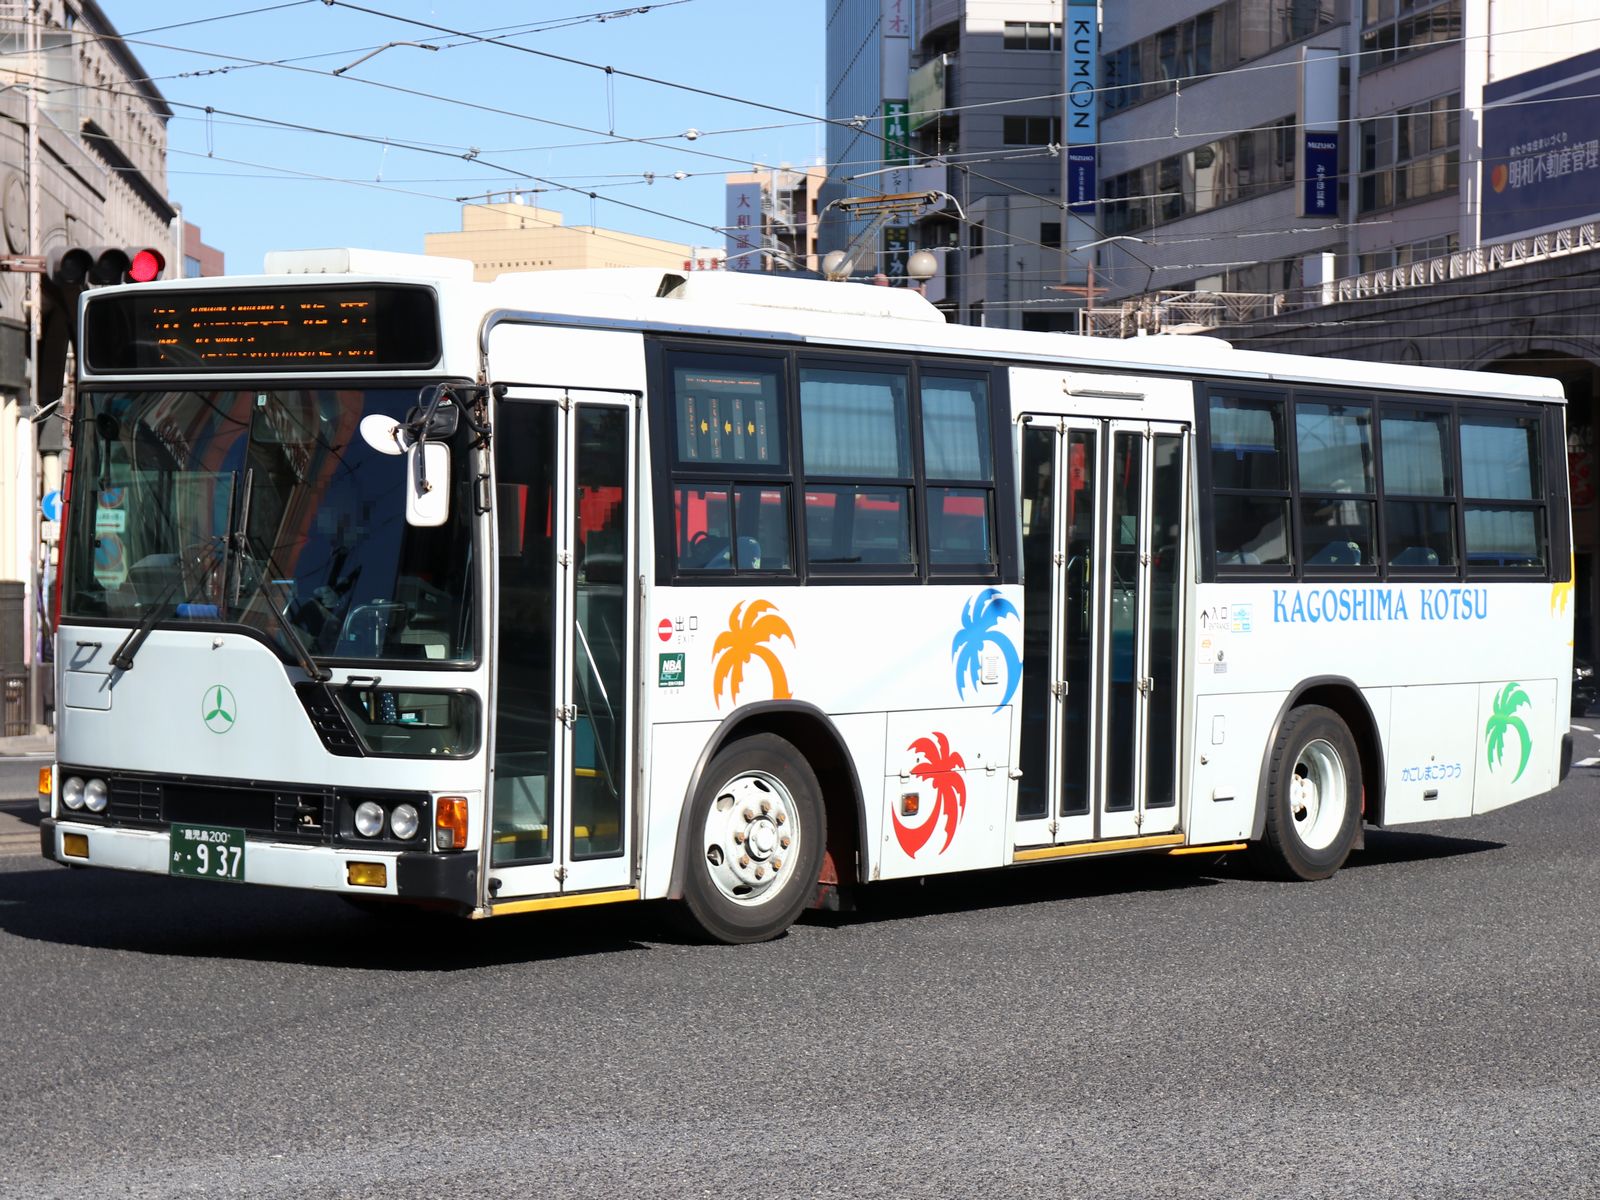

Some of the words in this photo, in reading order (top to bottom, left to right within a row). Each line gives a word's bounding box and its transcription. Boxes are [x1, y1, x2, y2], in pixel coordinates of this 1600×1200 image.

[1070, 20, 1094, 128] KUMON
[1509, 140, 1599, 189] 明和不動産管理
[1316, 164, 1326, 208] みずほ証券
[1272, 589, 1409, 623] KAGOSHIMA
[1420, 588, 1488, 621] KOTSU
[675, 615, 698, 632] 出口
[662, 660, 682, 672] NBA
[1402, 763, 1462, 782] かごしまこうつう
